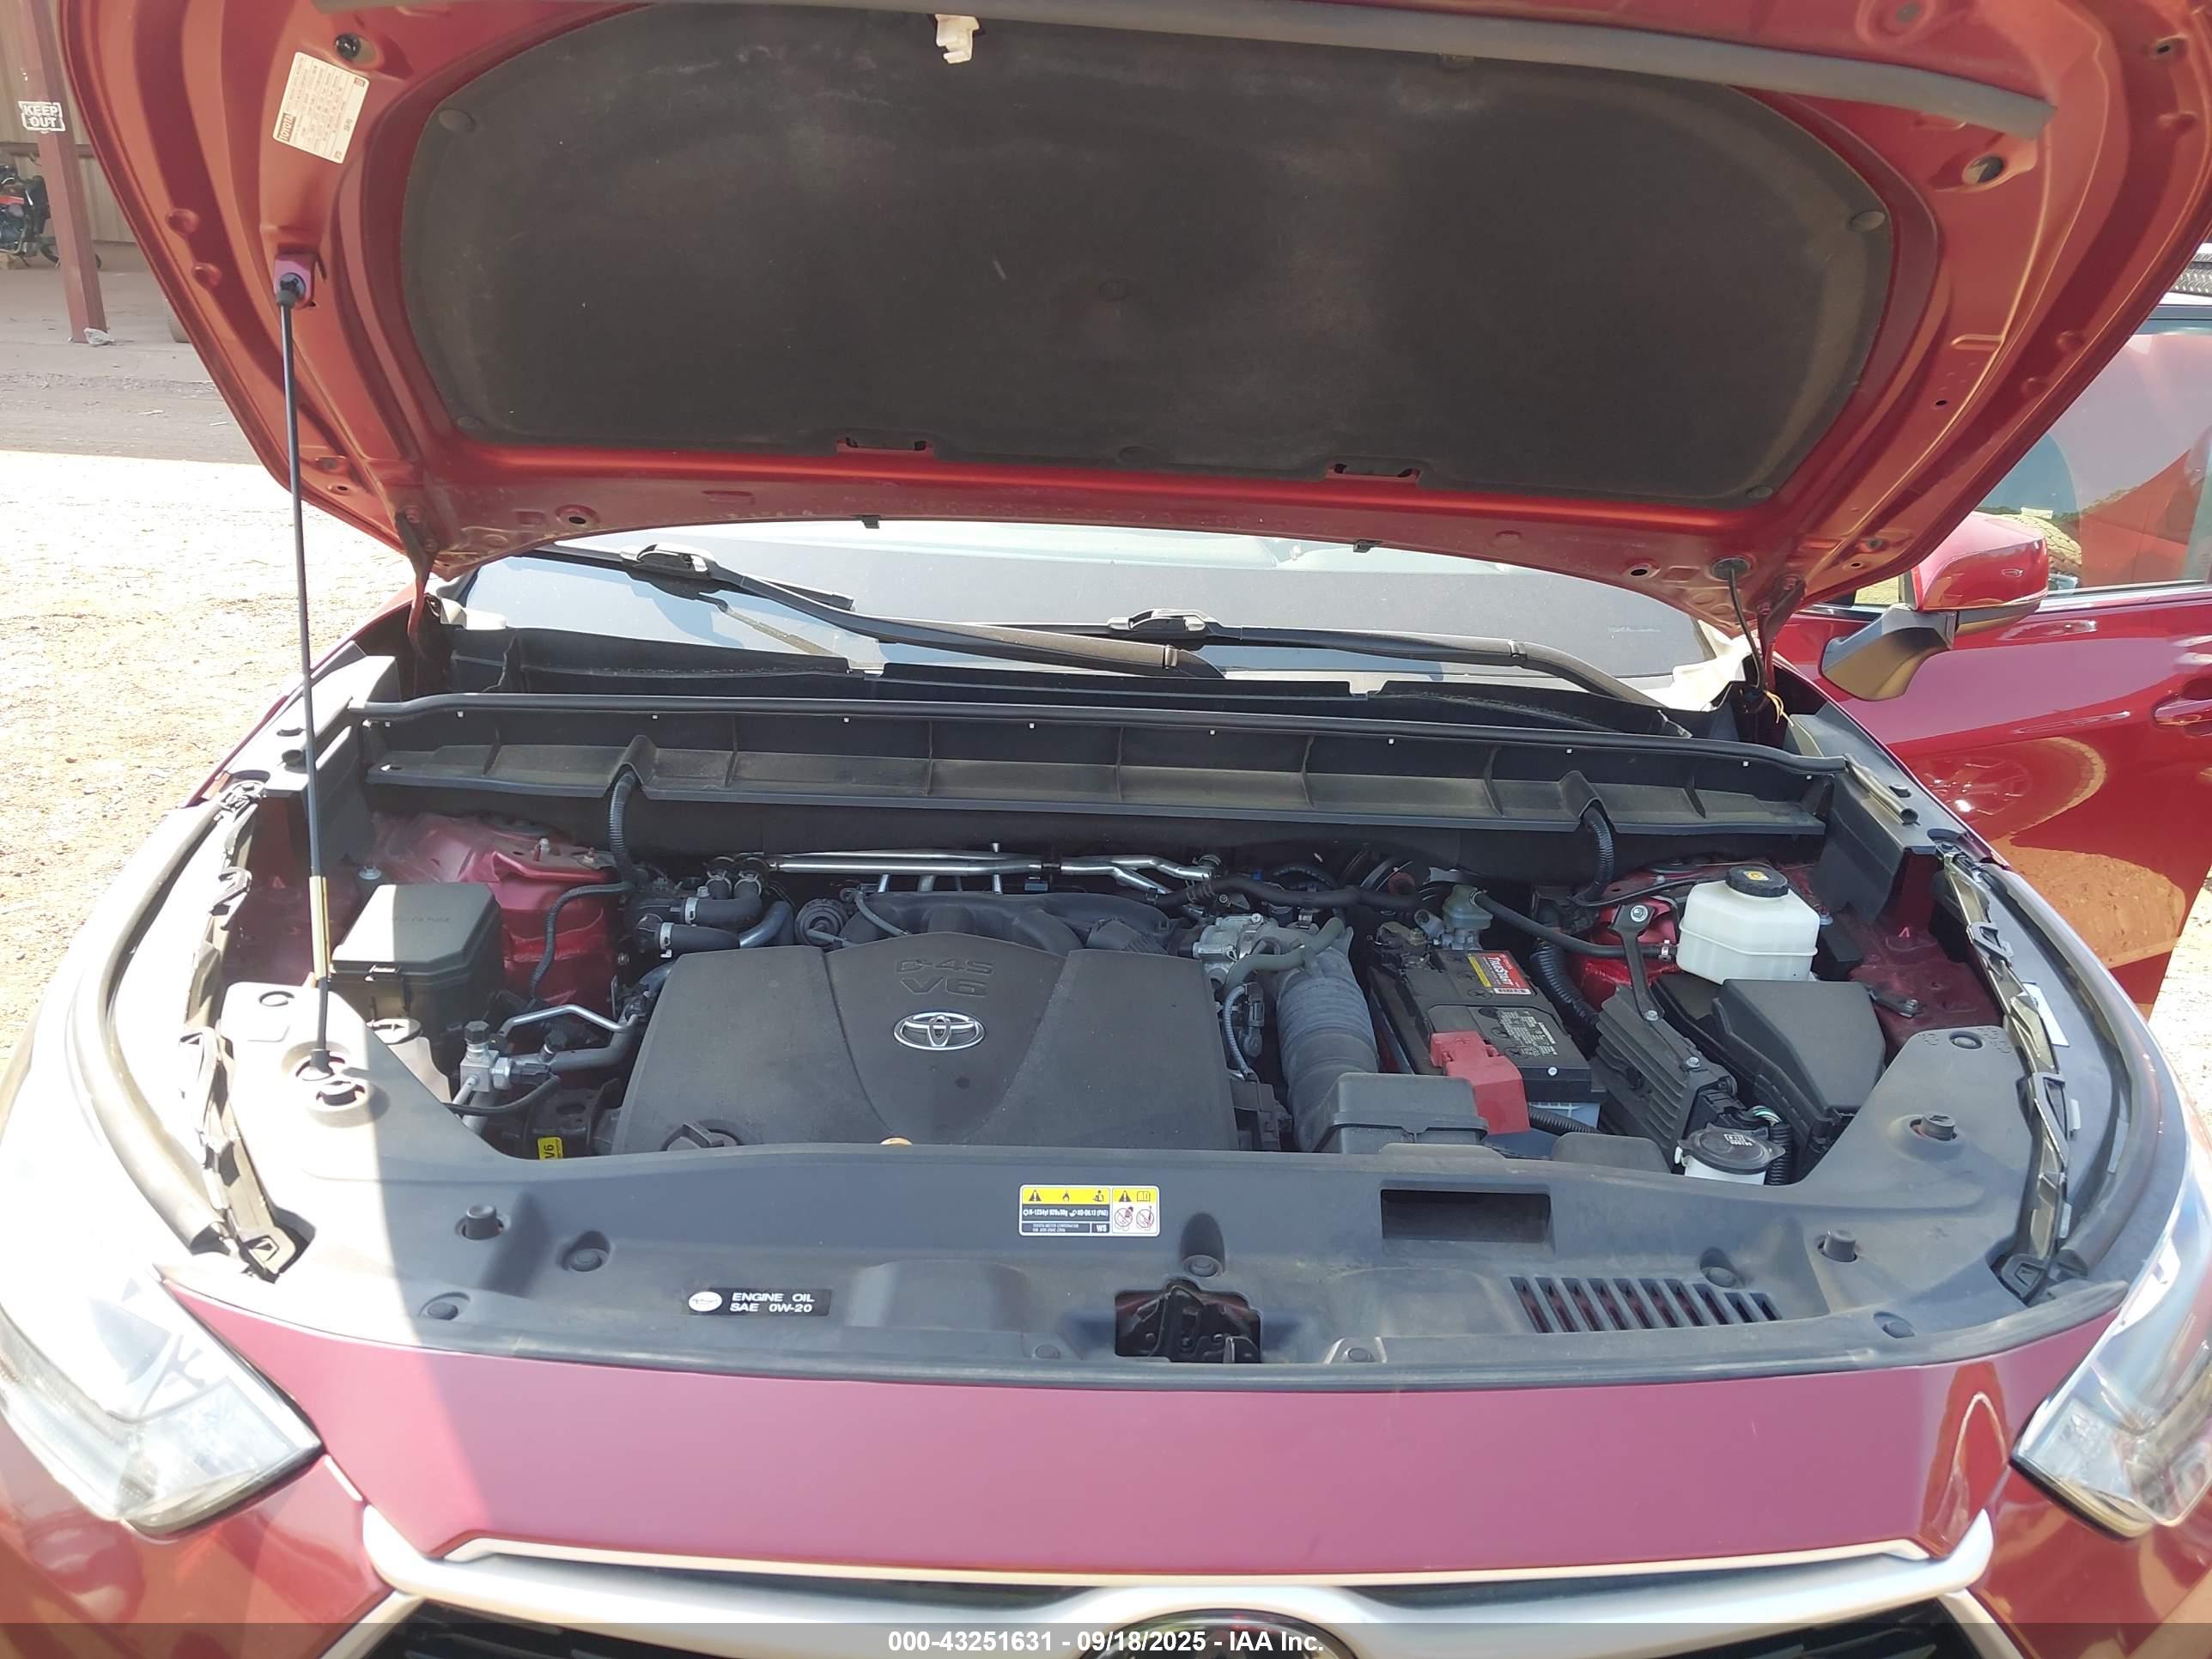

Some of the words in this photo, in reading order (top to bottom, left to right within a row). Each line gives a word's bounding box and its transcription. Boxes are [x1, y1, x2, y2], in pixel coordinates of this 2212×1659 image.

[23, 105, 58, 116] KEEP
[29, 116, 57, 128] OUT
[279, 112, 295, 143] TOYOTA
[896, 959, 994, 975] D-4S
[900, 976, 989, 997] V6
[544, 1144, 555, 1159] V6
[732, 1292, 784, 1302] ENGINE
[792, 1293, 815, 1303] OIL
[730, 1303, 760, 1312] SAE
[769, 1304, 812, 1313] 0W-20
